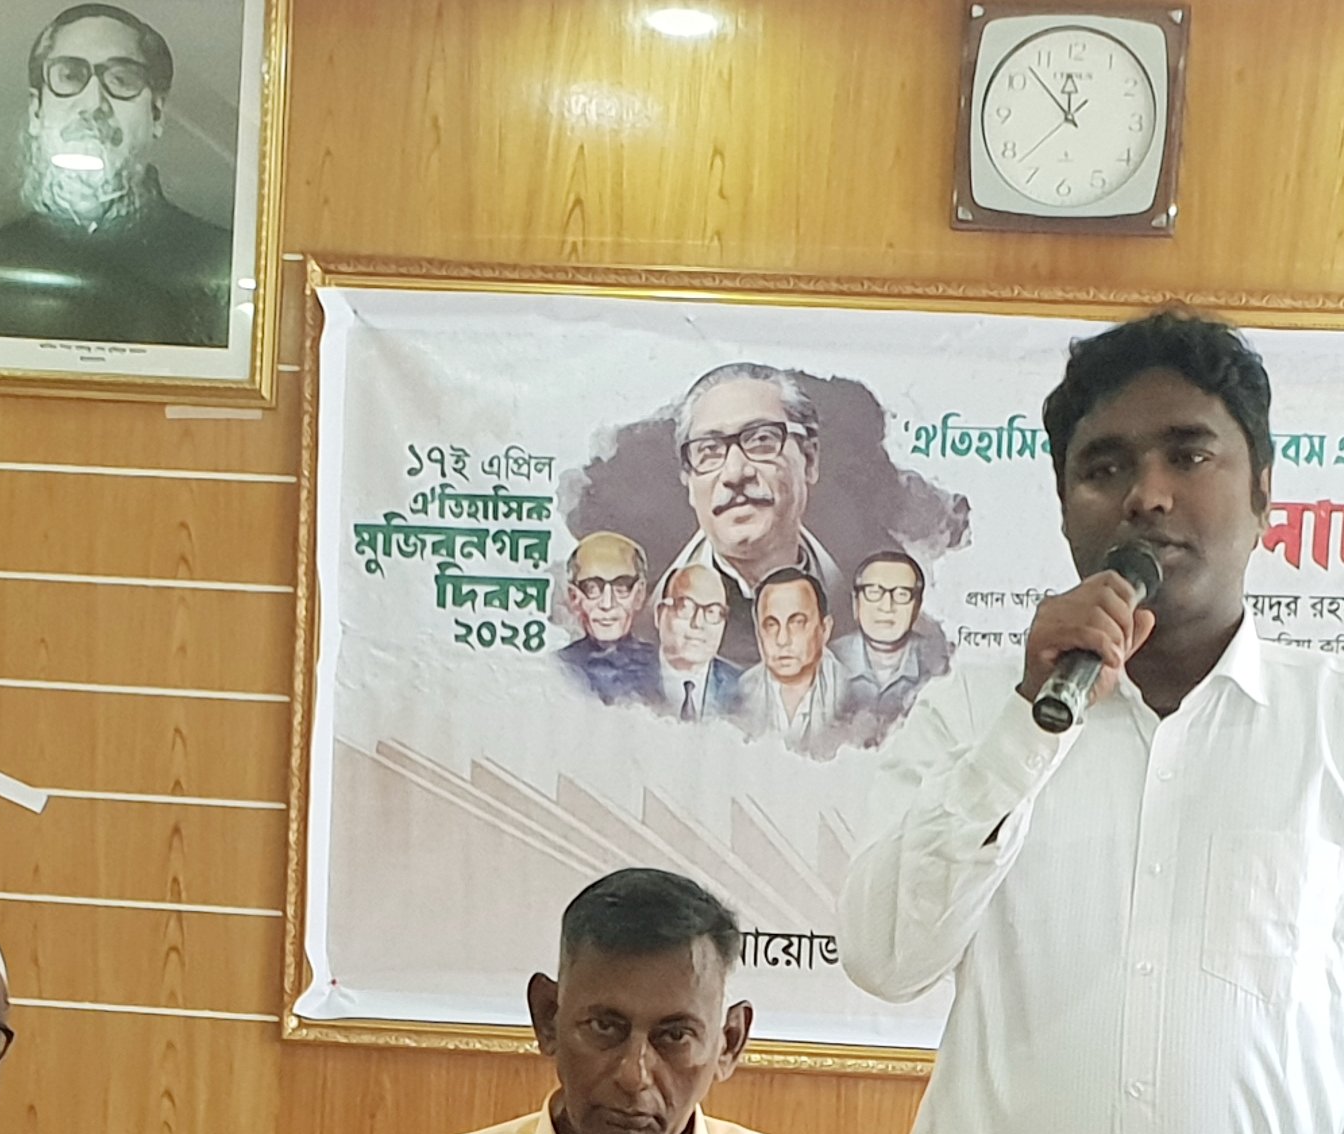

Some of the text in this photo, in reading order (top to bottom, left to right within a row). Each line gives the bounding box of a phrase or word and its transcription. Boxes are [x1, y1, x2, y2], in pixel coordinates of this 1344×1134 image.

[1037, 50, 1052, 68] 11
[1068, 41, 1087, 61] 12
[1007, 73, 1027, 91] 10
[1123, 79, 1138, 98] 2
[996, 107, 1012, 125] 9
[1128, 113, 1144, 132] 3
[1001, 141, 1017, 159] 8
[1116, 147, 1132, 166] 4
[1025, 167, 1041, 185] 7
[1090, 170, 1107, 189] 5
[1055, 179, 1071, 197] 6
[1269, 433, 1326, 468] বস
[407, 443, 555, 482] ১৭ই এপ্রিল
[410, 483, 553, 522] ঐতিহাসিক
[354, 511, 552, 579] মুজিবনগর
[434, 561, 550, 614] দিবস
[965, 591, 1006, 608] প্রধান
[454, 618, 546, 652] ২০২৪
[957, 626, 1003, 648] বিশেষ
